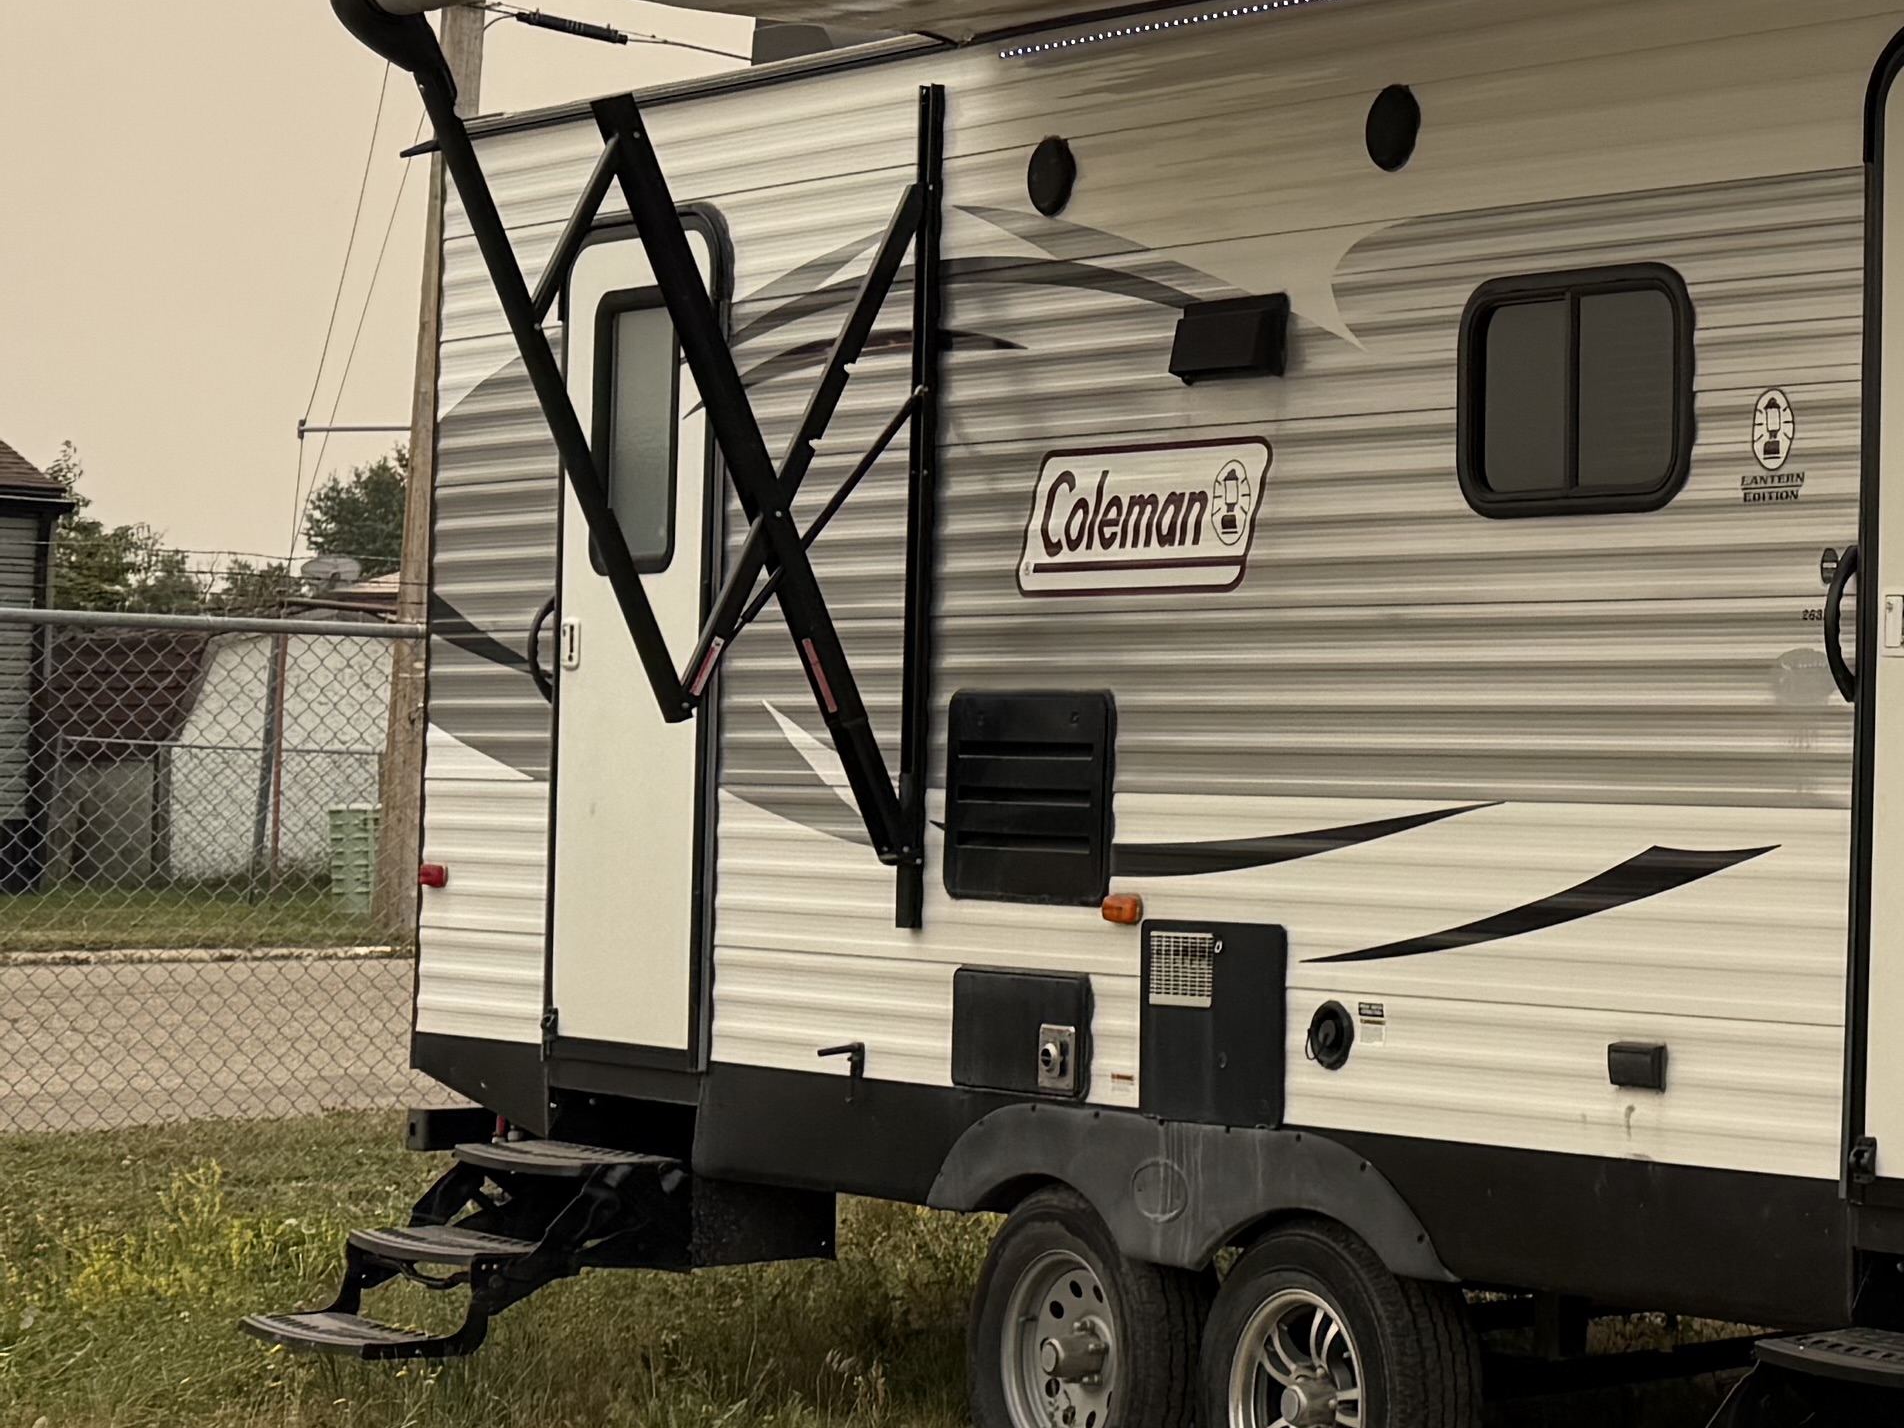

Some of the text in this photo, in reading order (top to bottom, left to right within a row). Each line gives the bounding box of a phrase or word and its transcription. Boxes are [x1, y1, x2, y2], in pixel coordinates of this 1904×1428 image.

[1741, 472, 1805, 486] LANTERN
[1743, 489, 1799, 503] EDITION
[1040, 470, 1209, 557] Coleman
